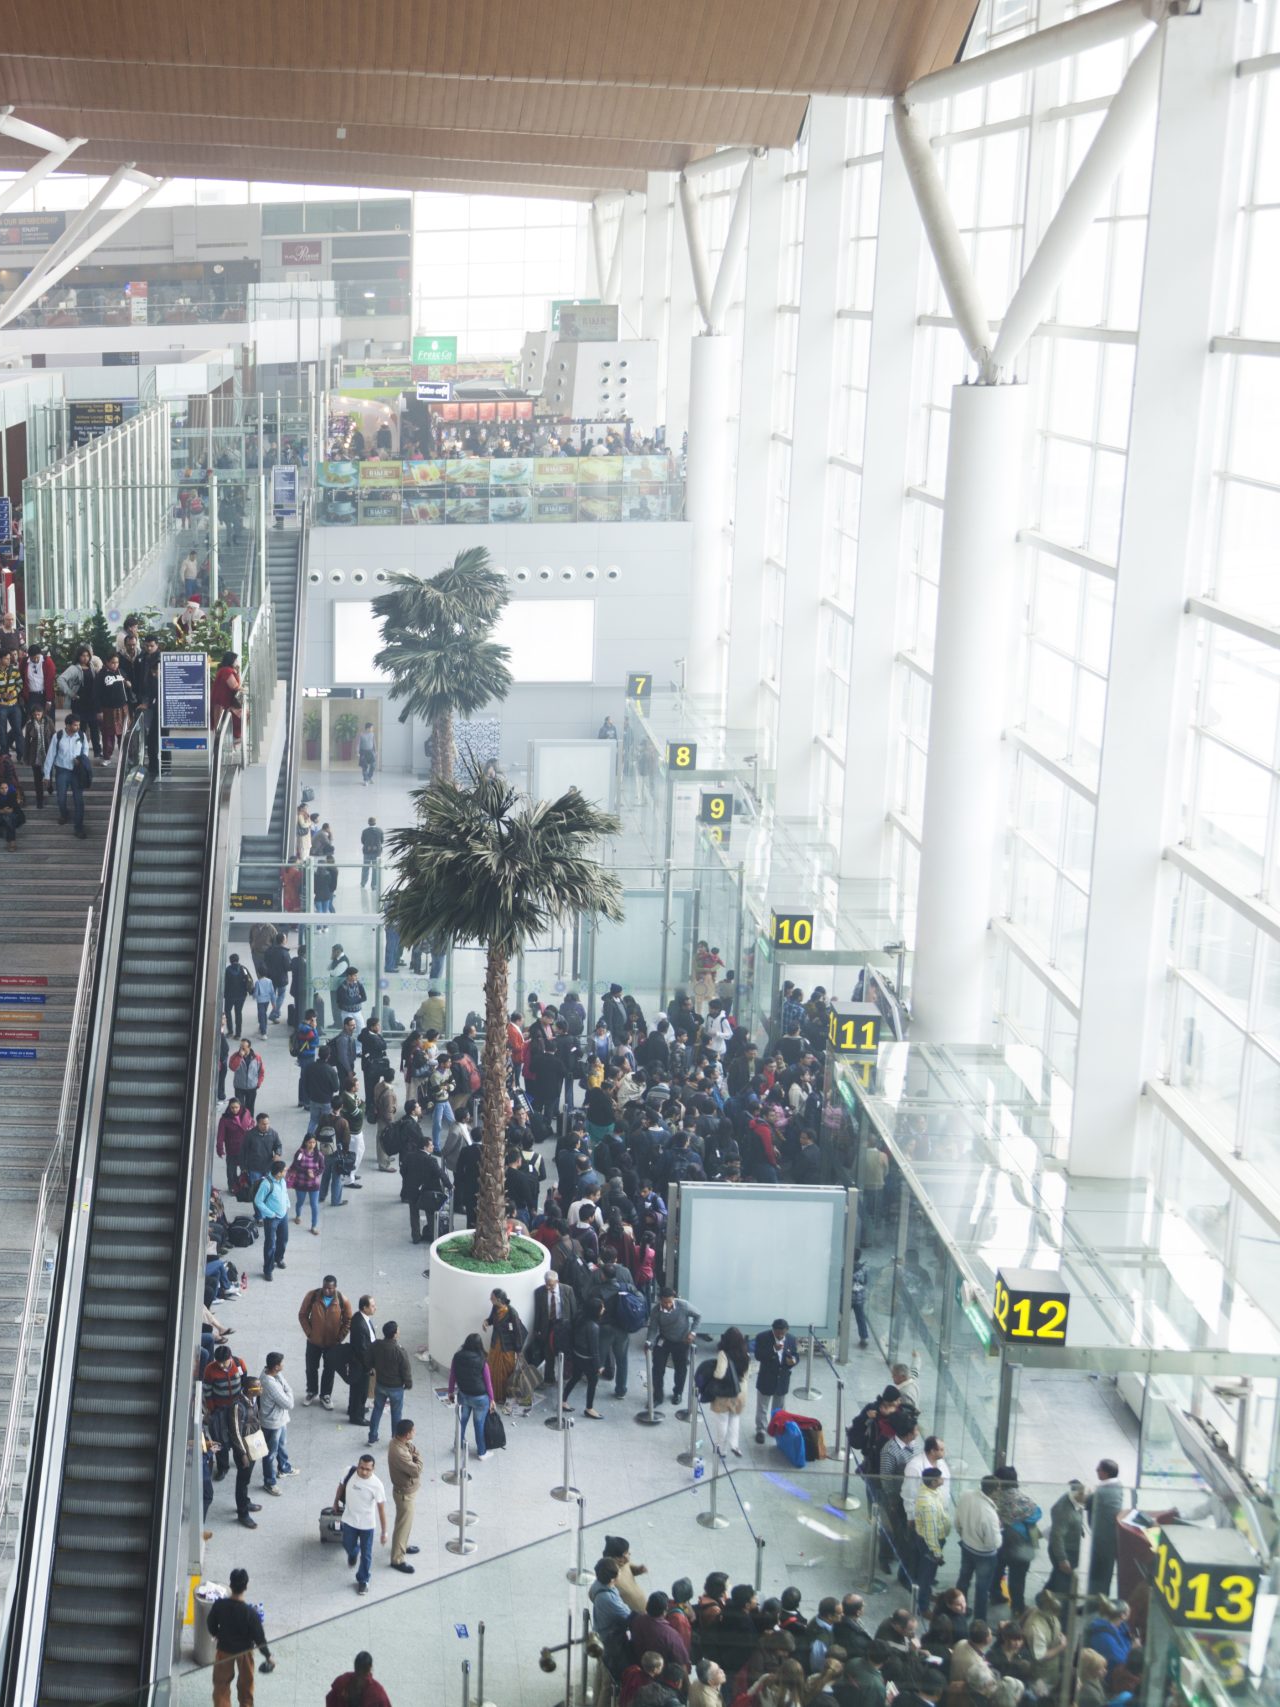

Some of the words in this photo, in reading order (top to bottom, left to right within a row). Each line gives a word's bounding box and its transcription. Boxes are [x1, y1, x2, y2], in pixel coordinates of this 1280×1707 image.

[635, 678, 646, 694] 7
[676, 746, 690, 766] 8
[710, 798, 724, 818] 9
[778, 919, 812, 945] 10
[841, 1020, 878, 1050] 11
[1012, 1298, 1067, 1339] 12
[1154, 1544, 1182, 1610] 13
[1184, 1572, 1256, 1624] 13
